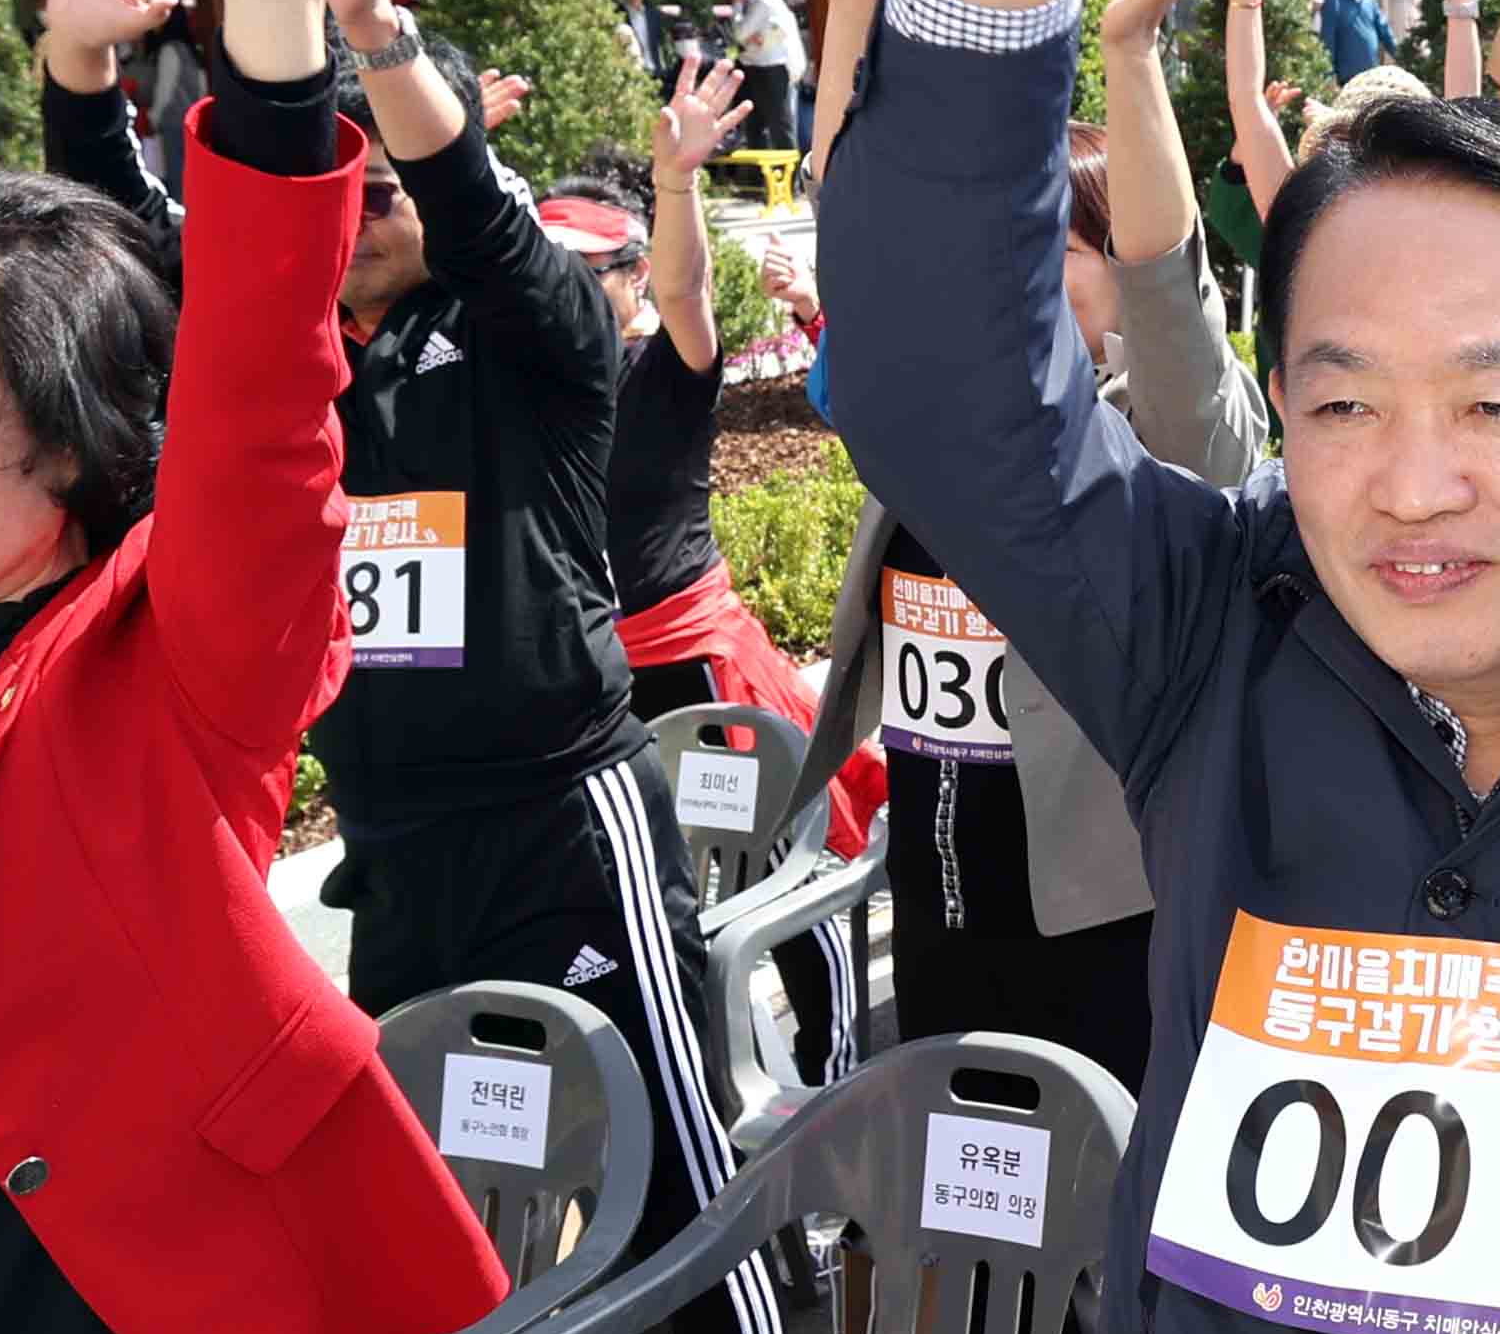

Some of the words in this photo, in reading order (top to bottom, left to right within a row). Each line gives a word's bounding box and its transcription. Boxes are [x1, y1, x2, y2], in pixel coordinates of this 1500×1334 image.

[415, 348, 464, 375] adidas
[345, 560, 422, 635] 81
[563, 959, 619, 987] adidas
[1263, 987, 1455, 1055] 동구걷기
[960, 1143, 1021, 1178] 유옥분
[934, 1183, 999, 1212] 동구의회
[1008, 1194, 1037, 1220] 의장
[1293, 1295, 1419, 1332] 인천광역시동구
